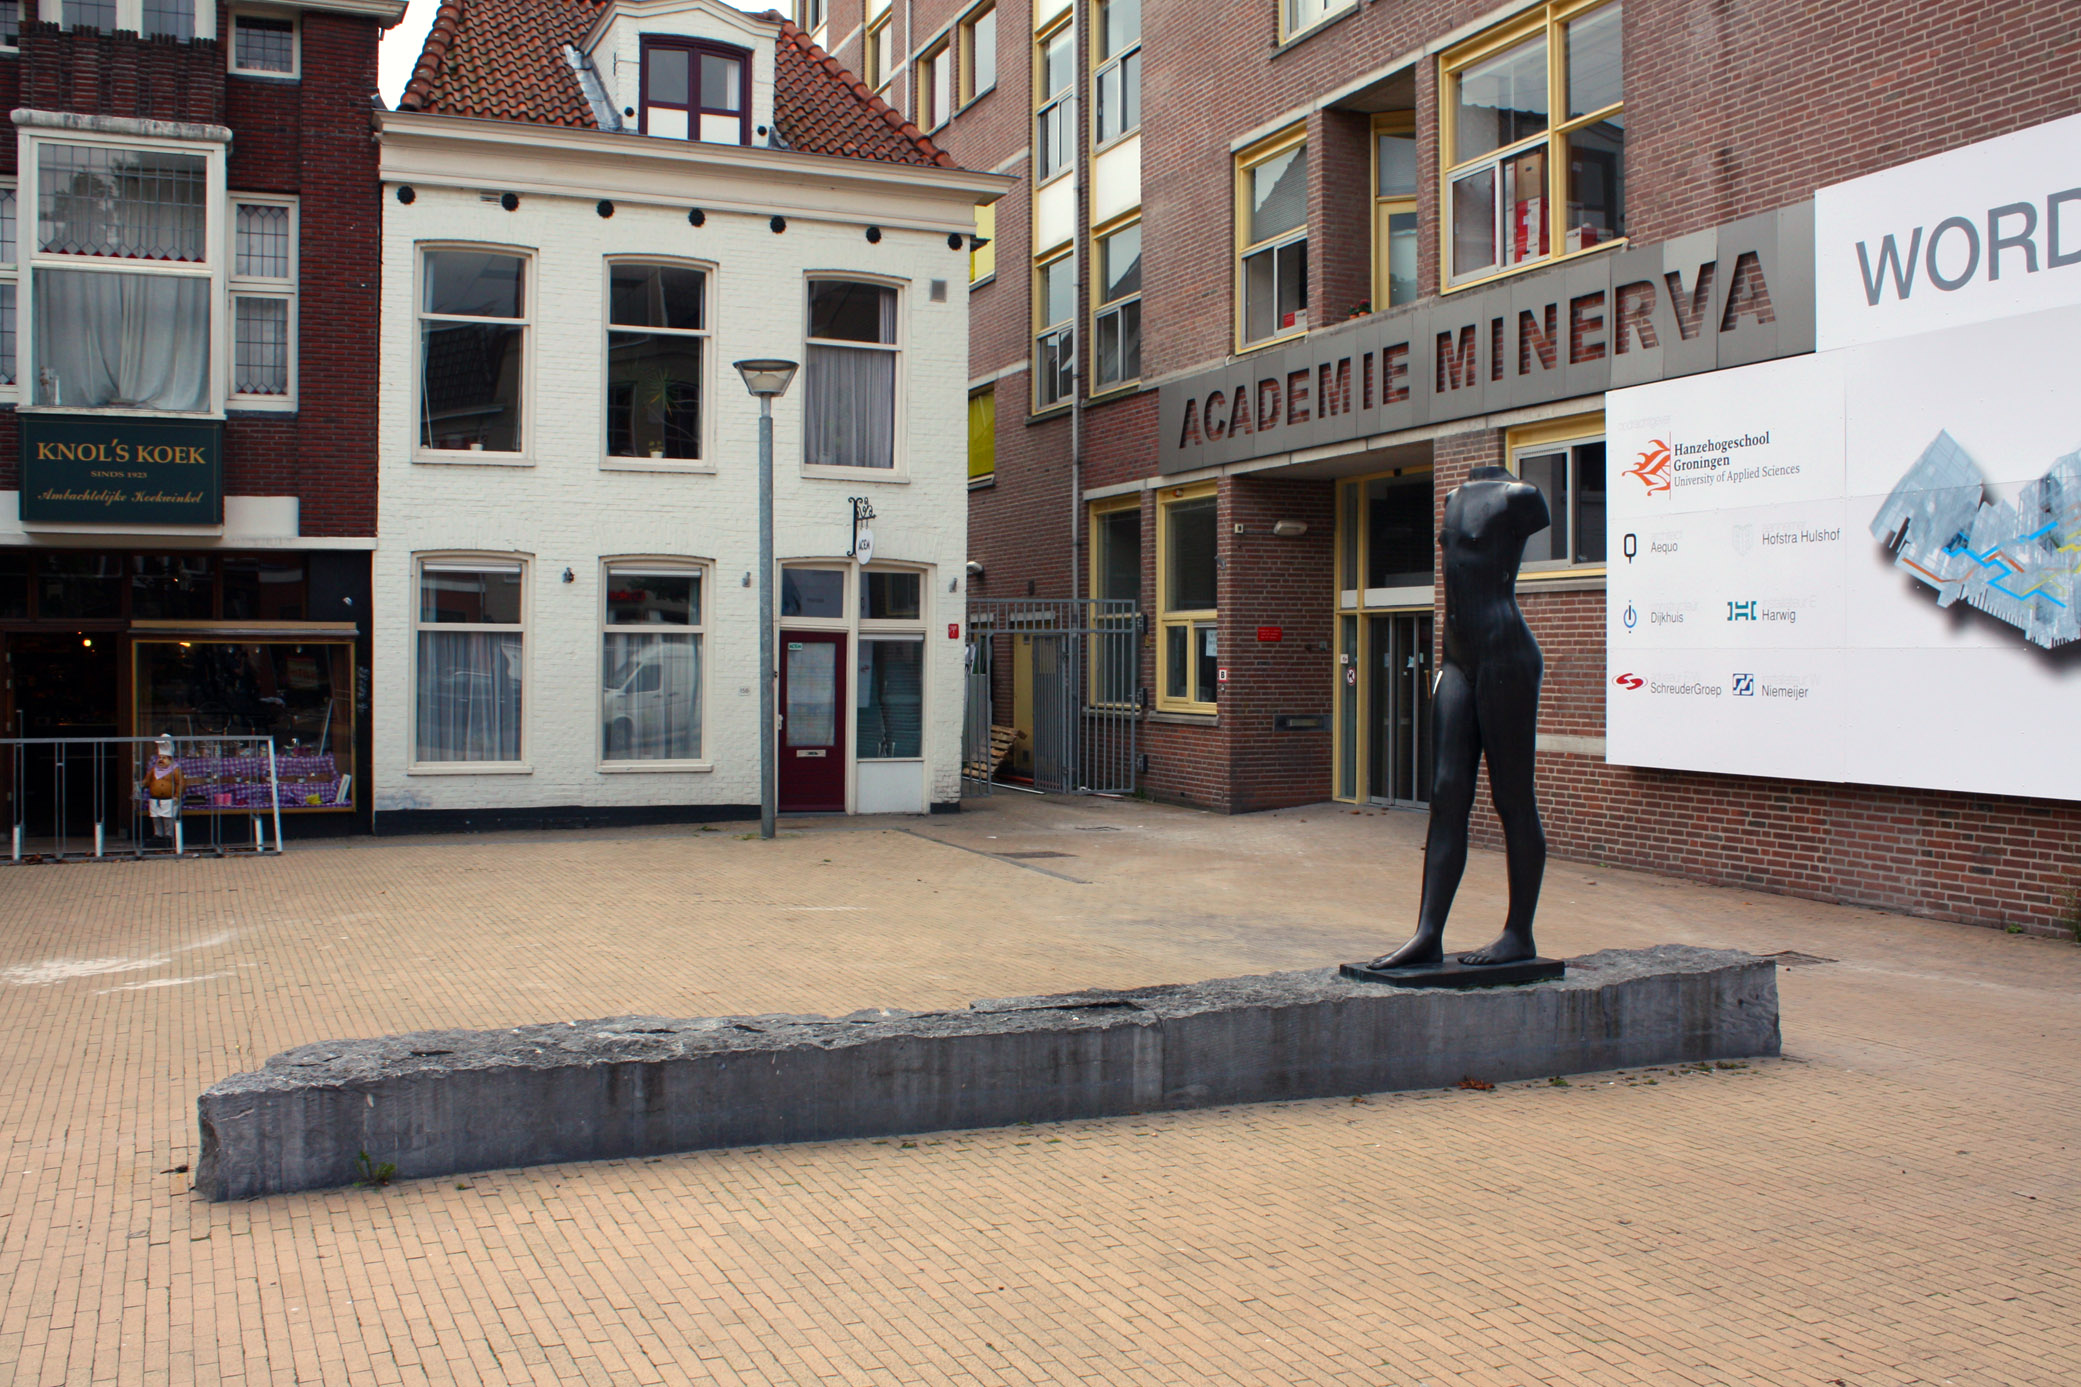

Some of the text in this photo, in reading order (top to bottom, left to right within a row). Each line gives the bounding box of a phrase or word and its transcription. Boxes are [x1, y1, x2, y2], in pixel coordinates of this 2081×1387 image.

[1855, 187, 2081, 307] WORD
[1179, 250, 1776, 449] ACADEMIE MINERVA
[37, 438, 206, 464] KNOL'S KOEK
[1674, 431, 1770, 456] Hanzehogeschool
[1673, 456, 1730, 471] Groningen
[1674, 464, 1800, 487] University of Applied Sciences
[37, 488, 204, 506] Ambachtelijke Koekwinkel
[1762, 528, 1841, 545] Hofstra Hulshof
[1650, 542, 1678, 555] Aequo
[1650, 611, 1684, 626] Dijkhuis
[1762, 609, 1796, 623] Harwig
[1650, 682, 1722, 698] SchreuderGroep
[1762, 684, 1809, 700] Niemeijer
